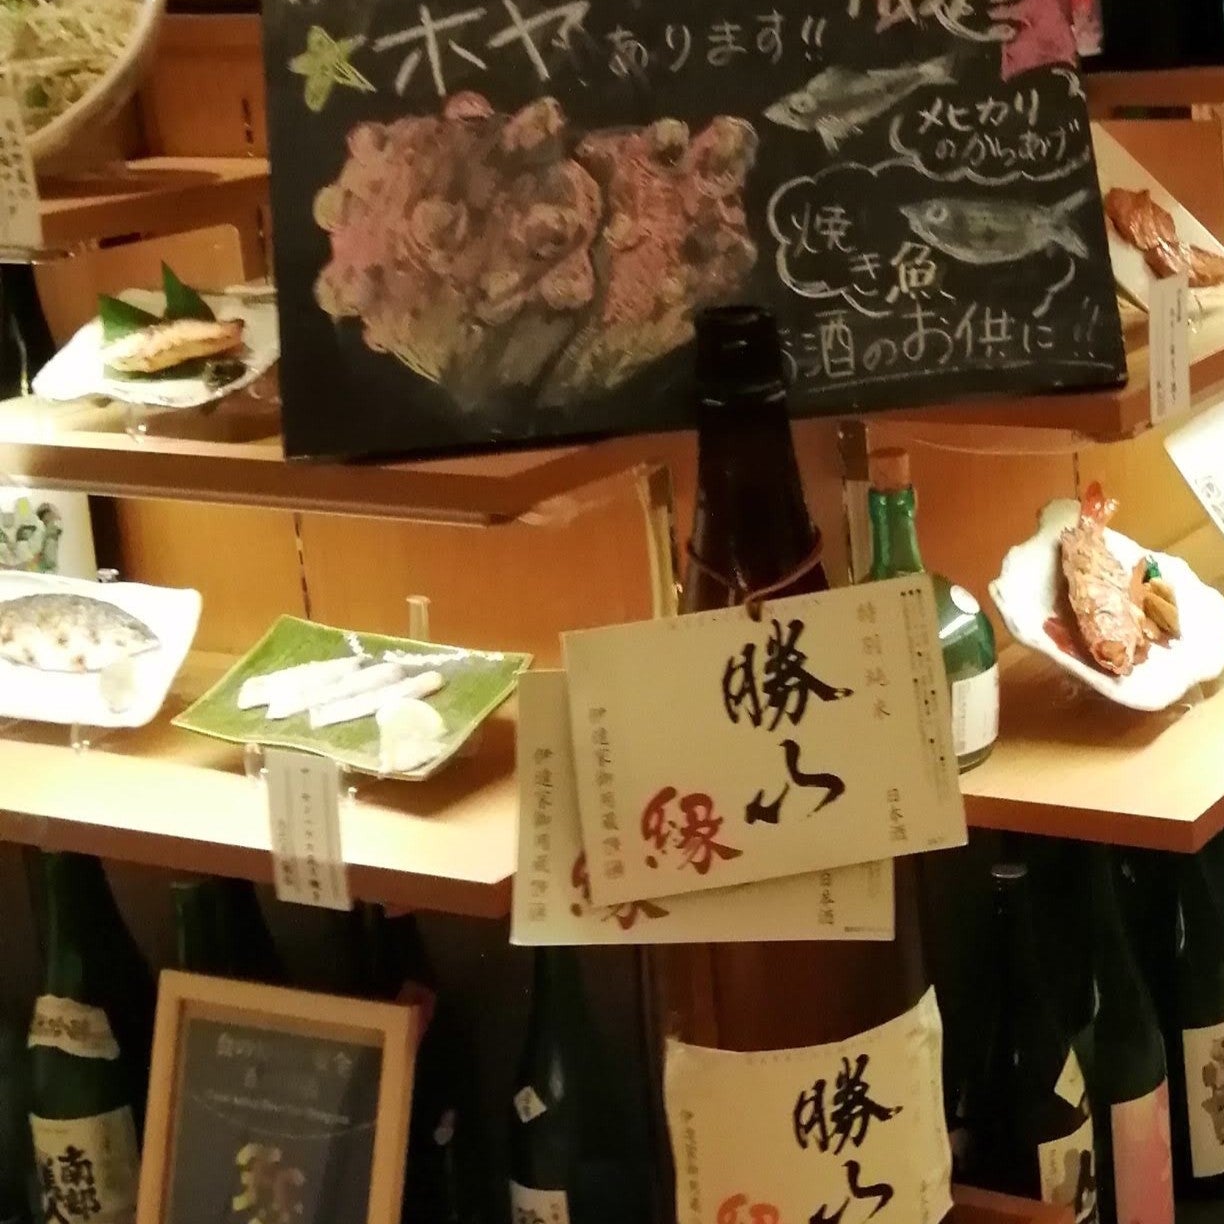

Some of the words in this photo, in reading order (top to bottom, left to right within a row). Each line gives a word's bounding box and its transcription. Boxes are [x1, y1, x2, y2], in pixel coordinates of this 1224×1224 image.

[917, 89, 1038, 134] メヒカリ
[791, 203, 957, 303] 焼き魚
[722, 619, 853, 825] 勝山
